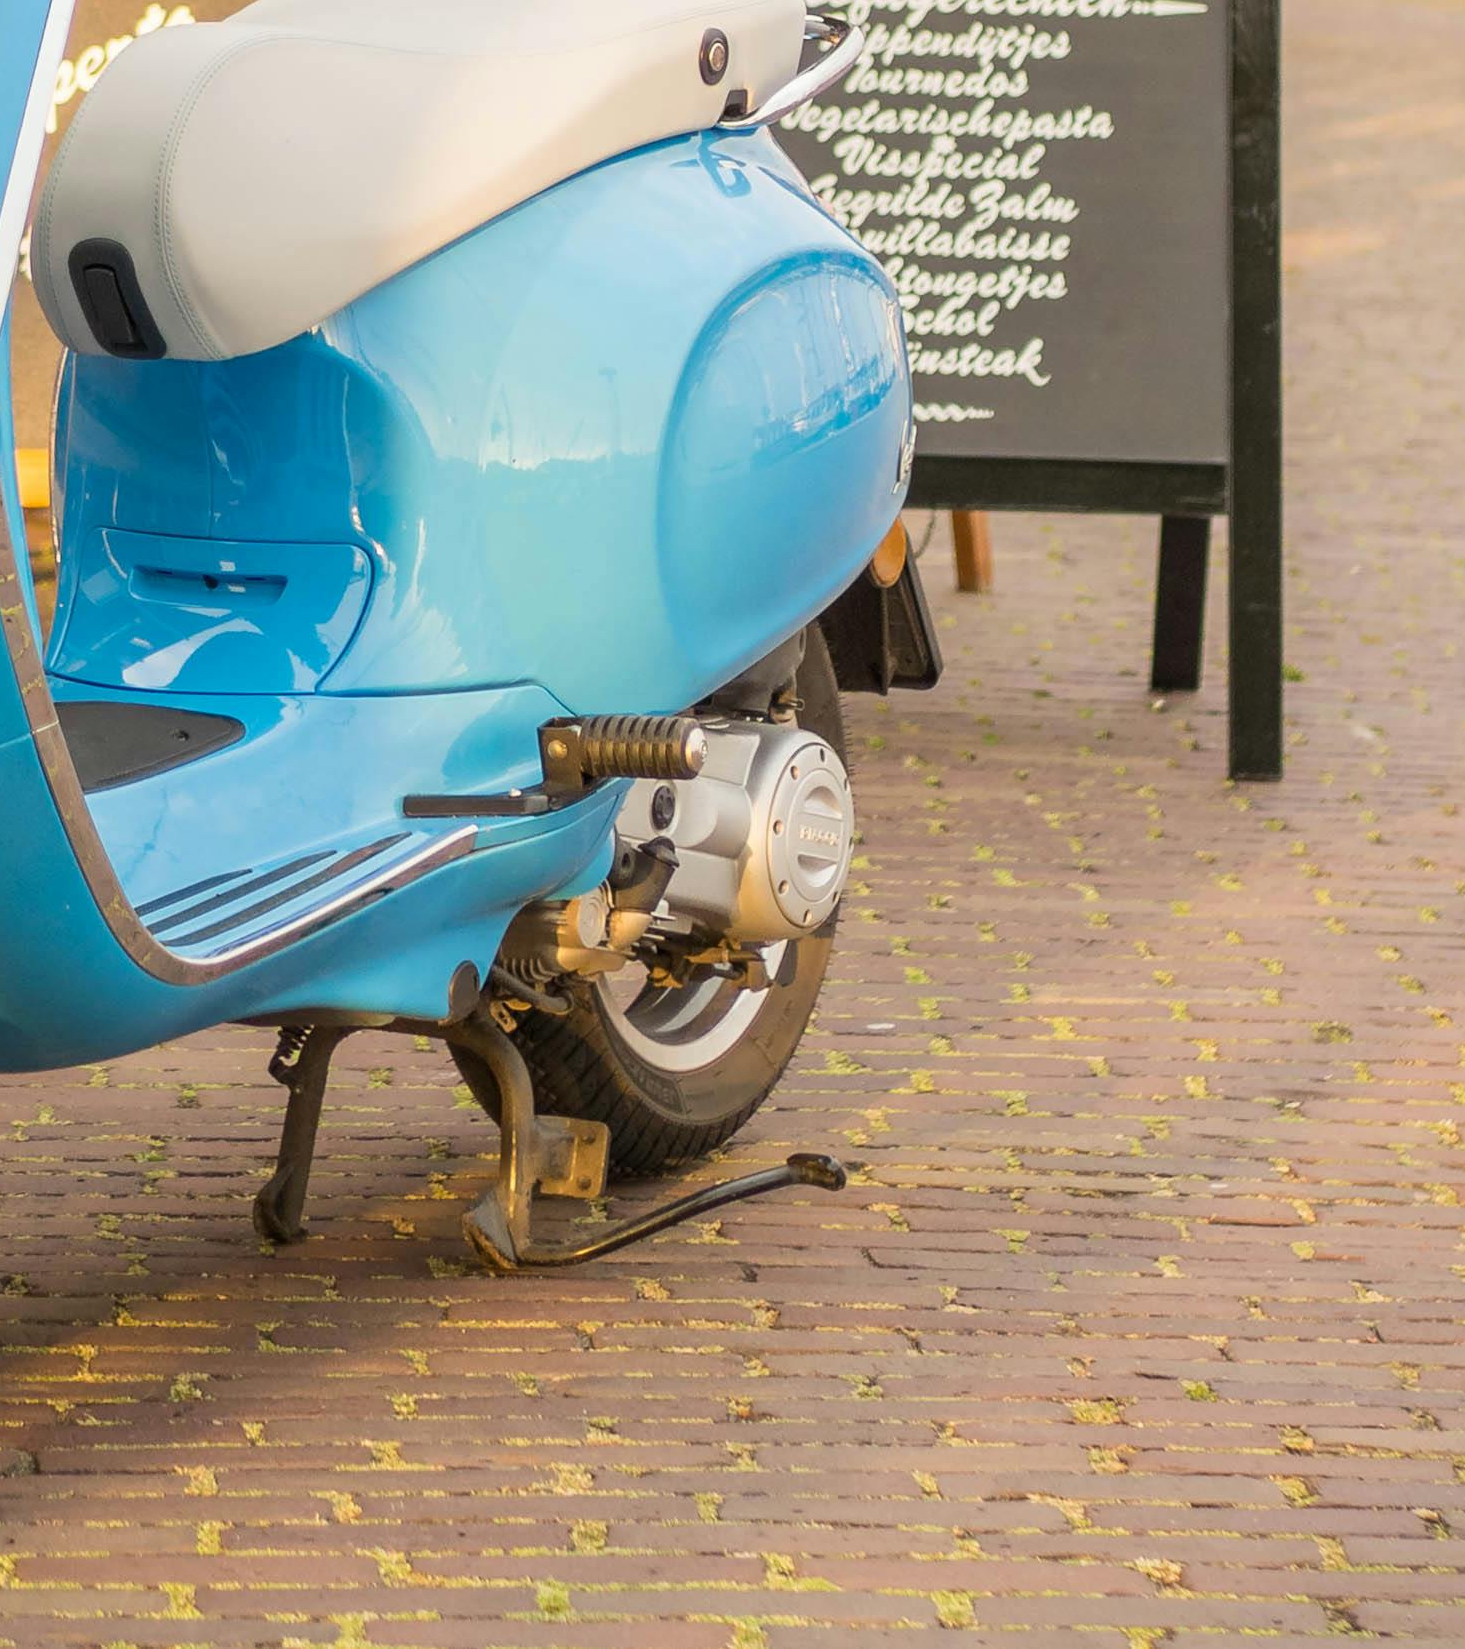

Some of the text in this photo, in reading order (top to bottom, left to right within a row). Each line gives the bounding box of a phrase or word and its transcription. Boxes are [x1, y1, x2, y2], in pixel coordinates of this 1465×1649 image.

[833, 134, 1047, 189] Visspecial
[968, 178, 1081, 232] Zalm
[835, 211, 1072, 262] uillabaisse
